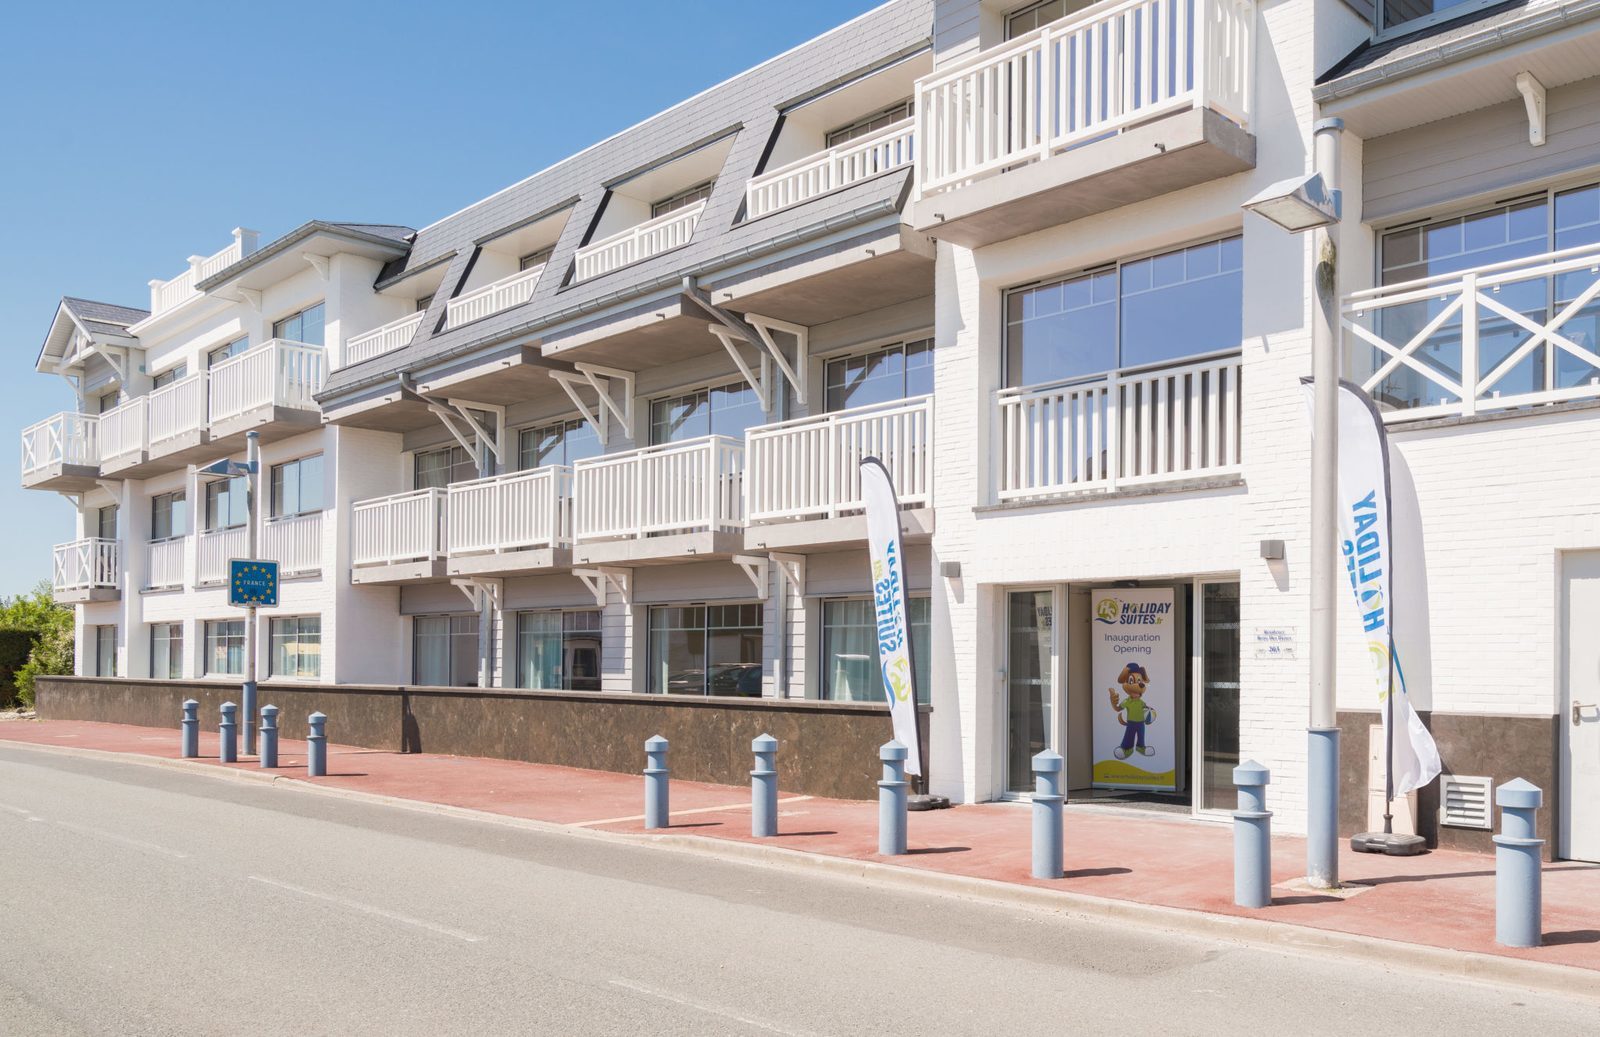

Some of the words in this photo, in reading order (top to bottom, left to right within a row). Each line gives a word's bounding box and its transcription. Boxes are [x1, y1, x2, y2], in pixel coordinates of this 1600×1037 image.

[1121, 602, 1172, 614] HOLIDAY
[1104, 633, 1160, 644] Inauguration
[1113, 645, 1152, 655] Opening
